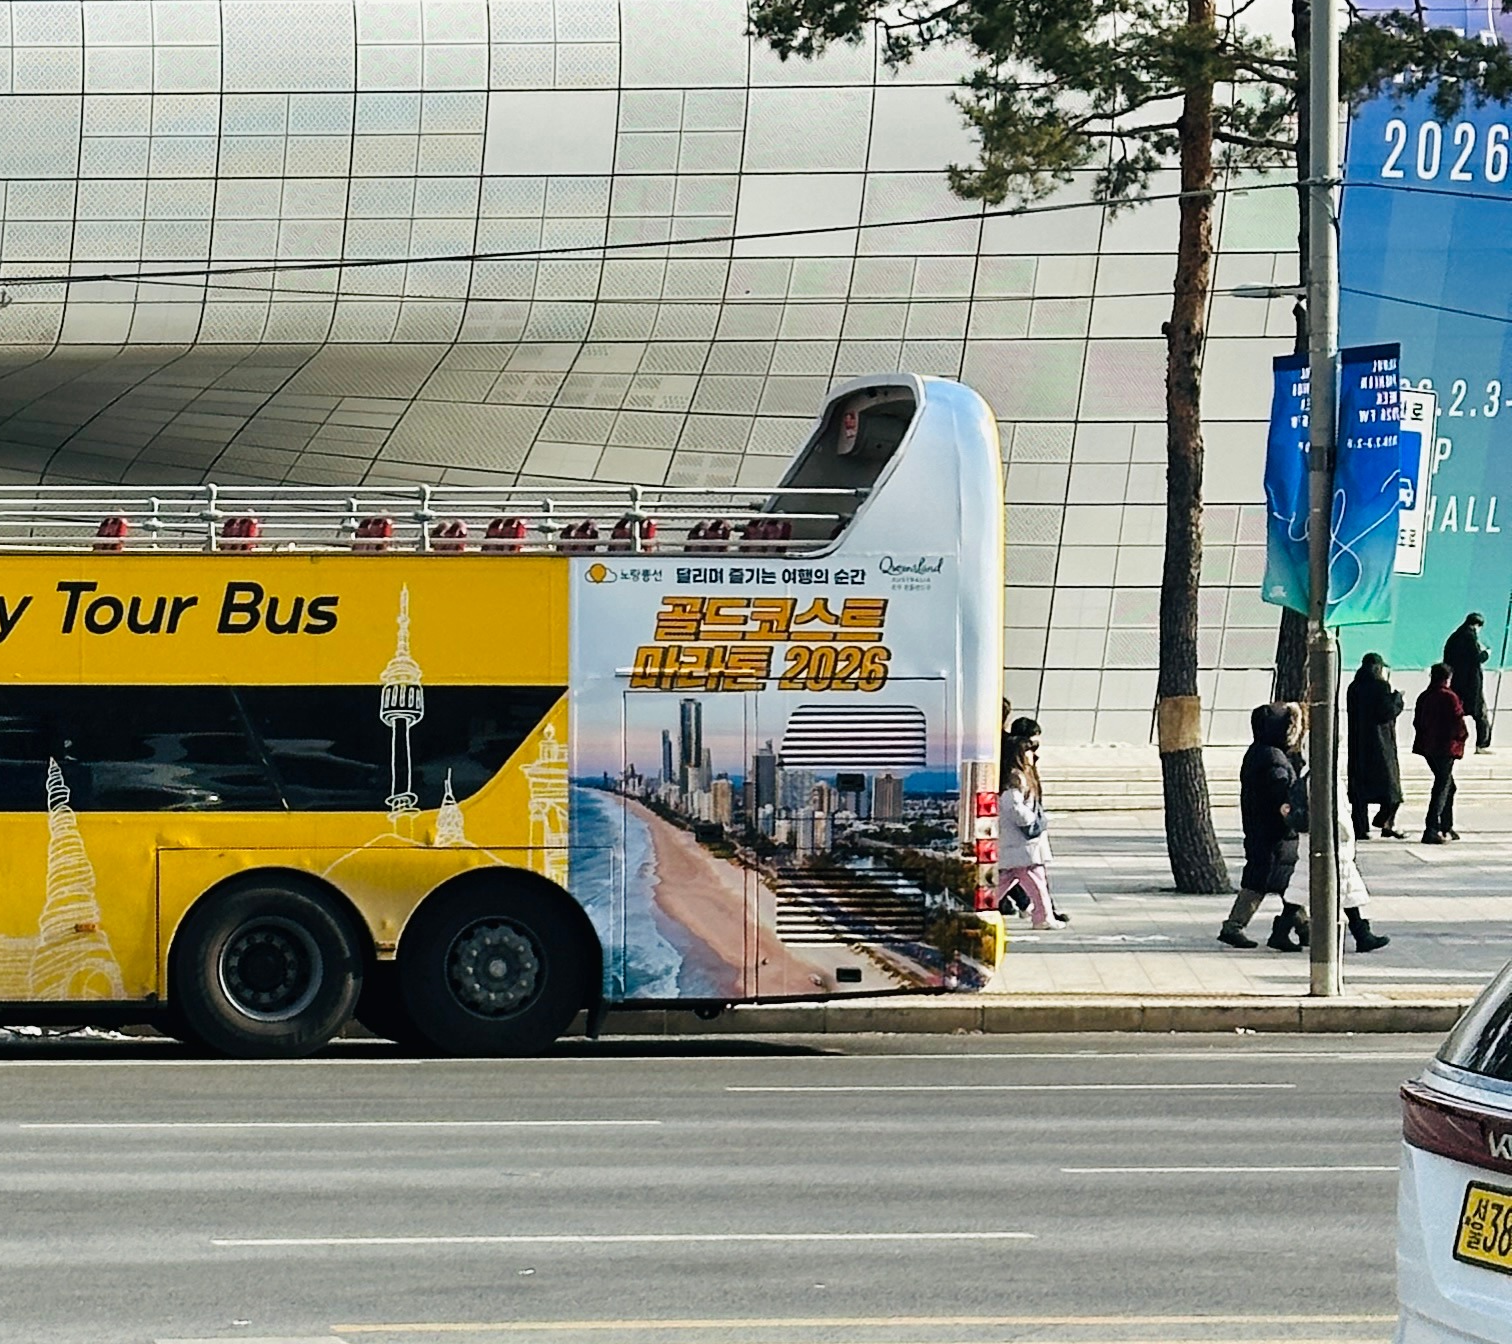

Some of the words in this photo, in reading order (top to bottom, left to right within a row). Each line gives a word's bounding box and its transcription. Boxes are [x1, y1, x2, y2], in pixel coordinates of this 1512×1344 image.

[1381, 119, 1510, 183] 2026
[619, 569, 663, 583] 노랑풍선
[728, 567, 777, 585] 즐기는
[781, 567, 830, 585] 여행의
[833, 567, 866, 585] 순간
[55, 580, 199, 635] Tour
[216, 580, 340, 635] Bus
[654, 596, 889, 642] 골드코스트
[629, 645, 774, 691] 마라톤
[777, 645, 892, 691] 2026
